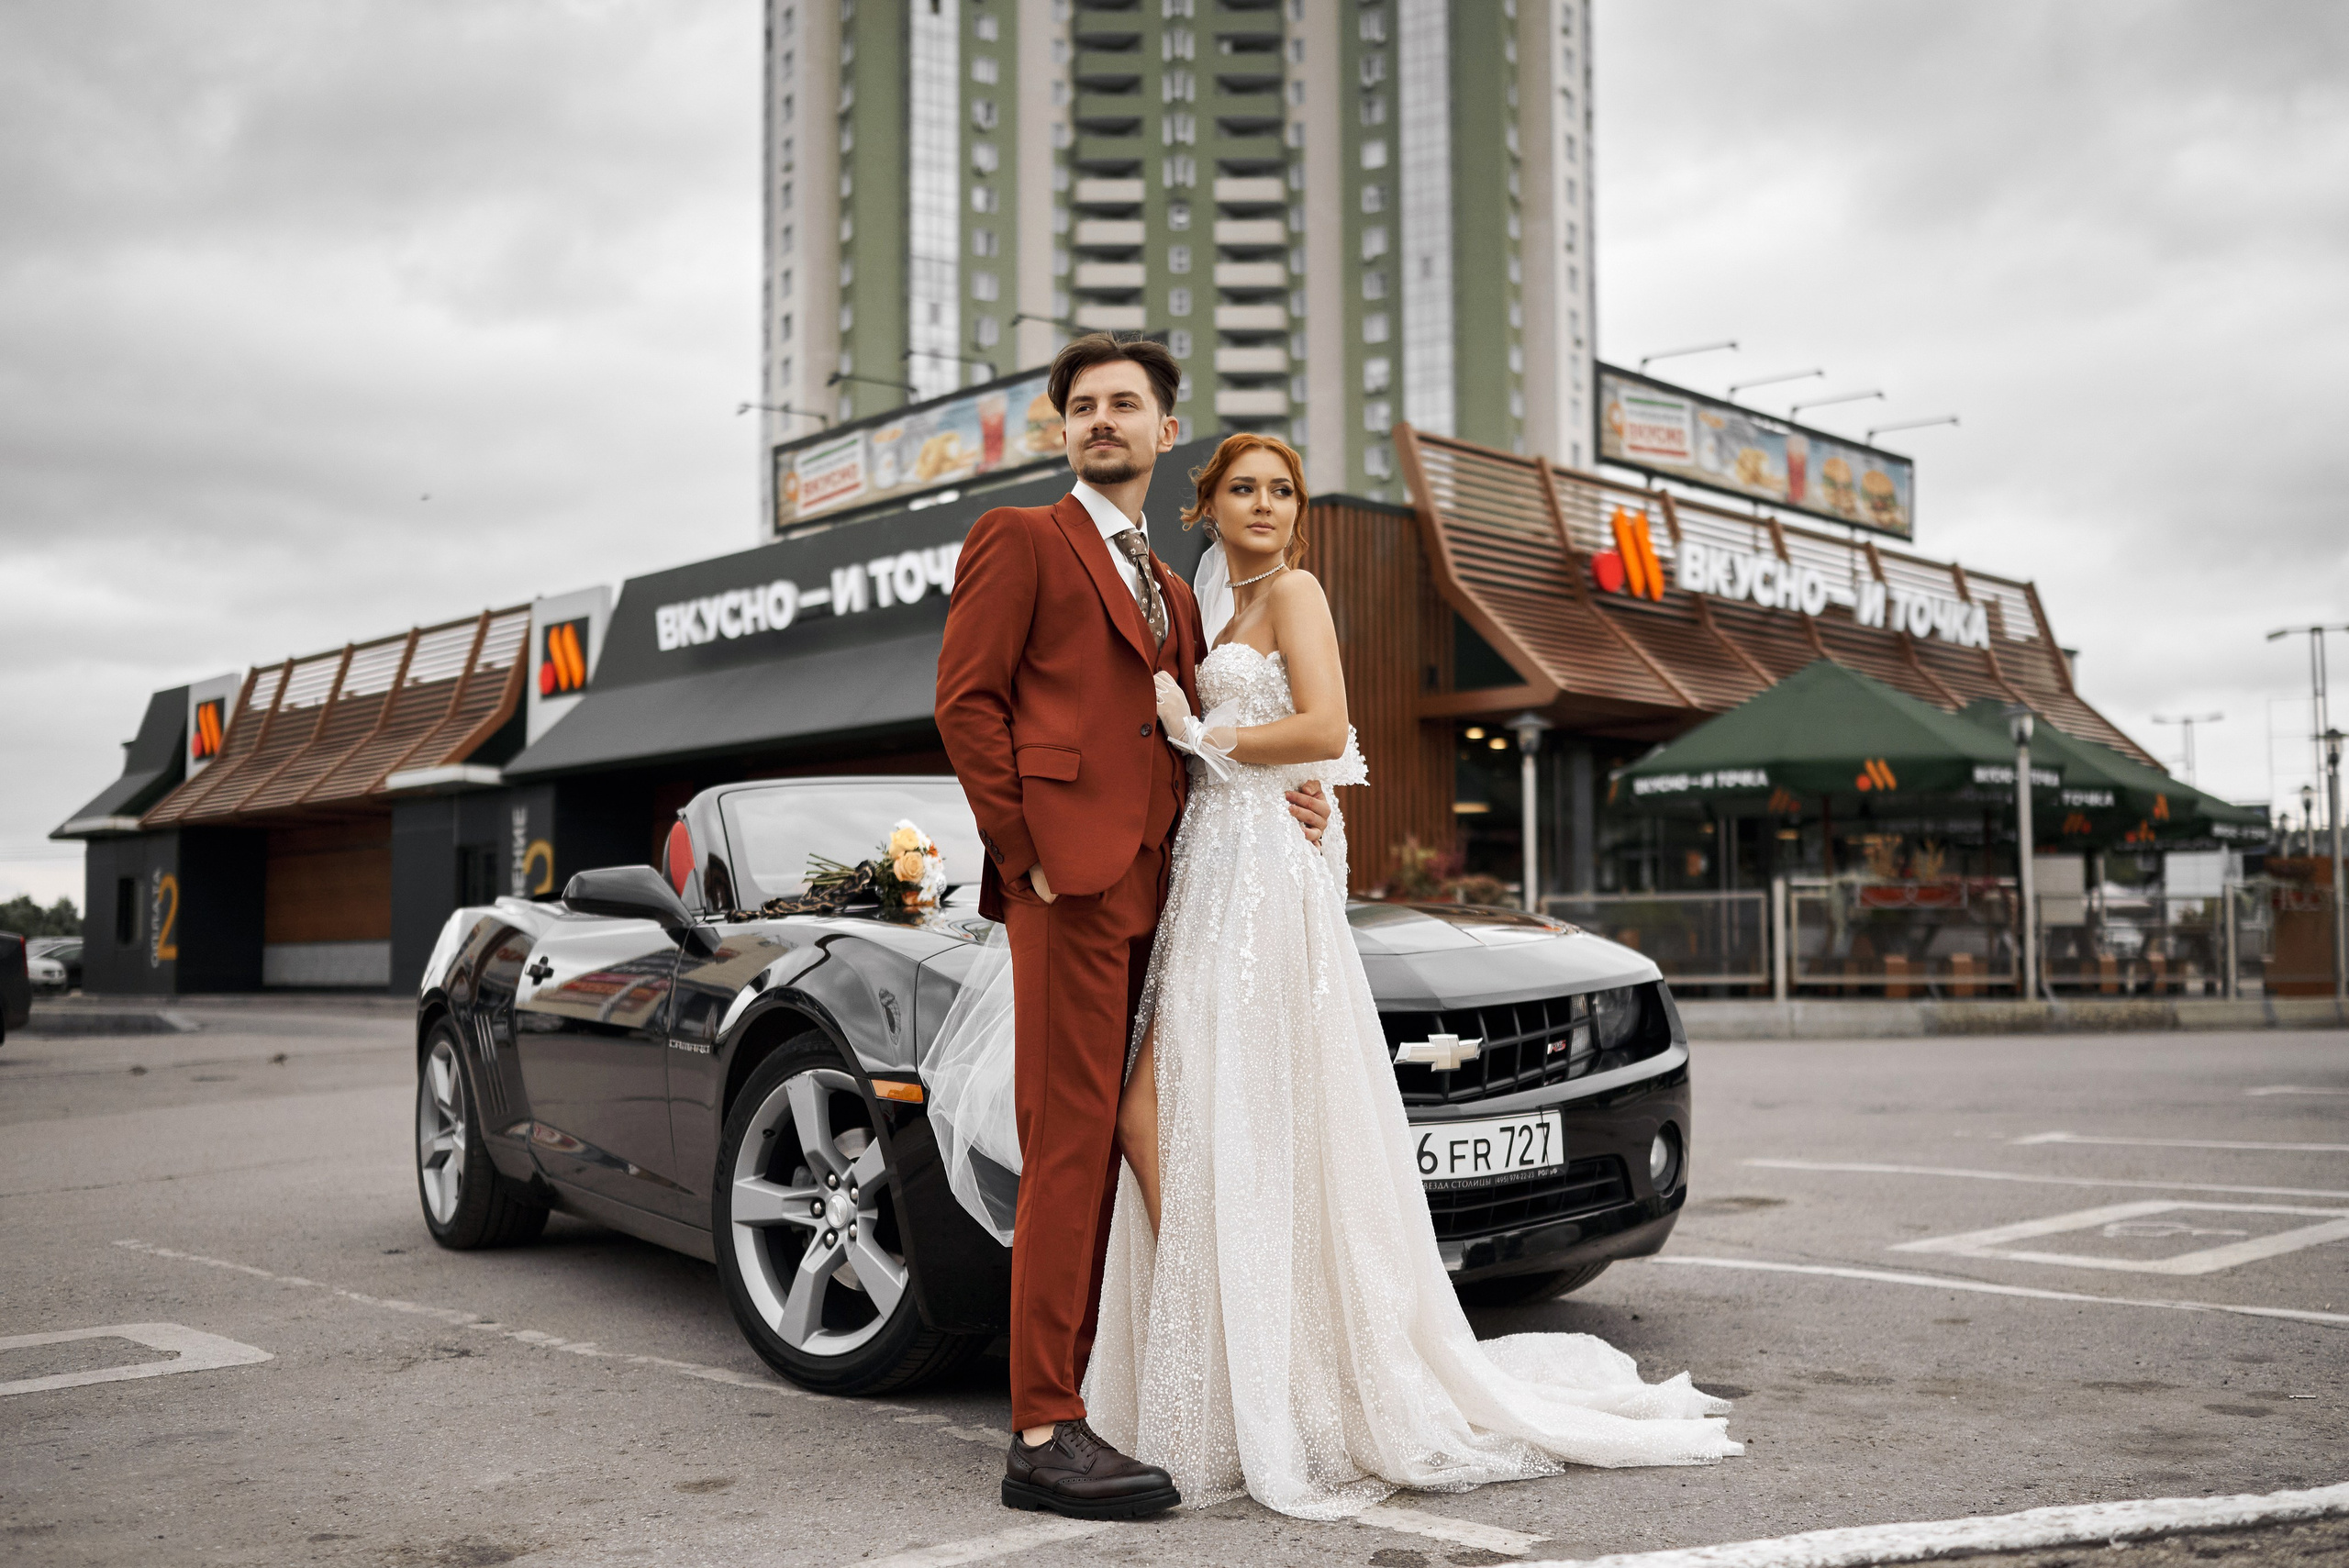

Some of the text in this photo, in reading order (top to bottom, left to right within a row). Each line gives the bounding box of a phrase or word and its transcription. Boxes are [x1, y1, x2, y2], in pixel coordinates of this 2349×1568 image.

[1891, 587, 1991, 651] ТОЧКА
[158, 873, 179, 961] 2
[1450, 1139, 1491, 1173] FR
[1499, 1122, 1551, 1168] 727
[1422, 1181, 1449, 1190] ВЕЗДА
[1451, 1178, 1491, 1189] СТОЛИЦЫ
